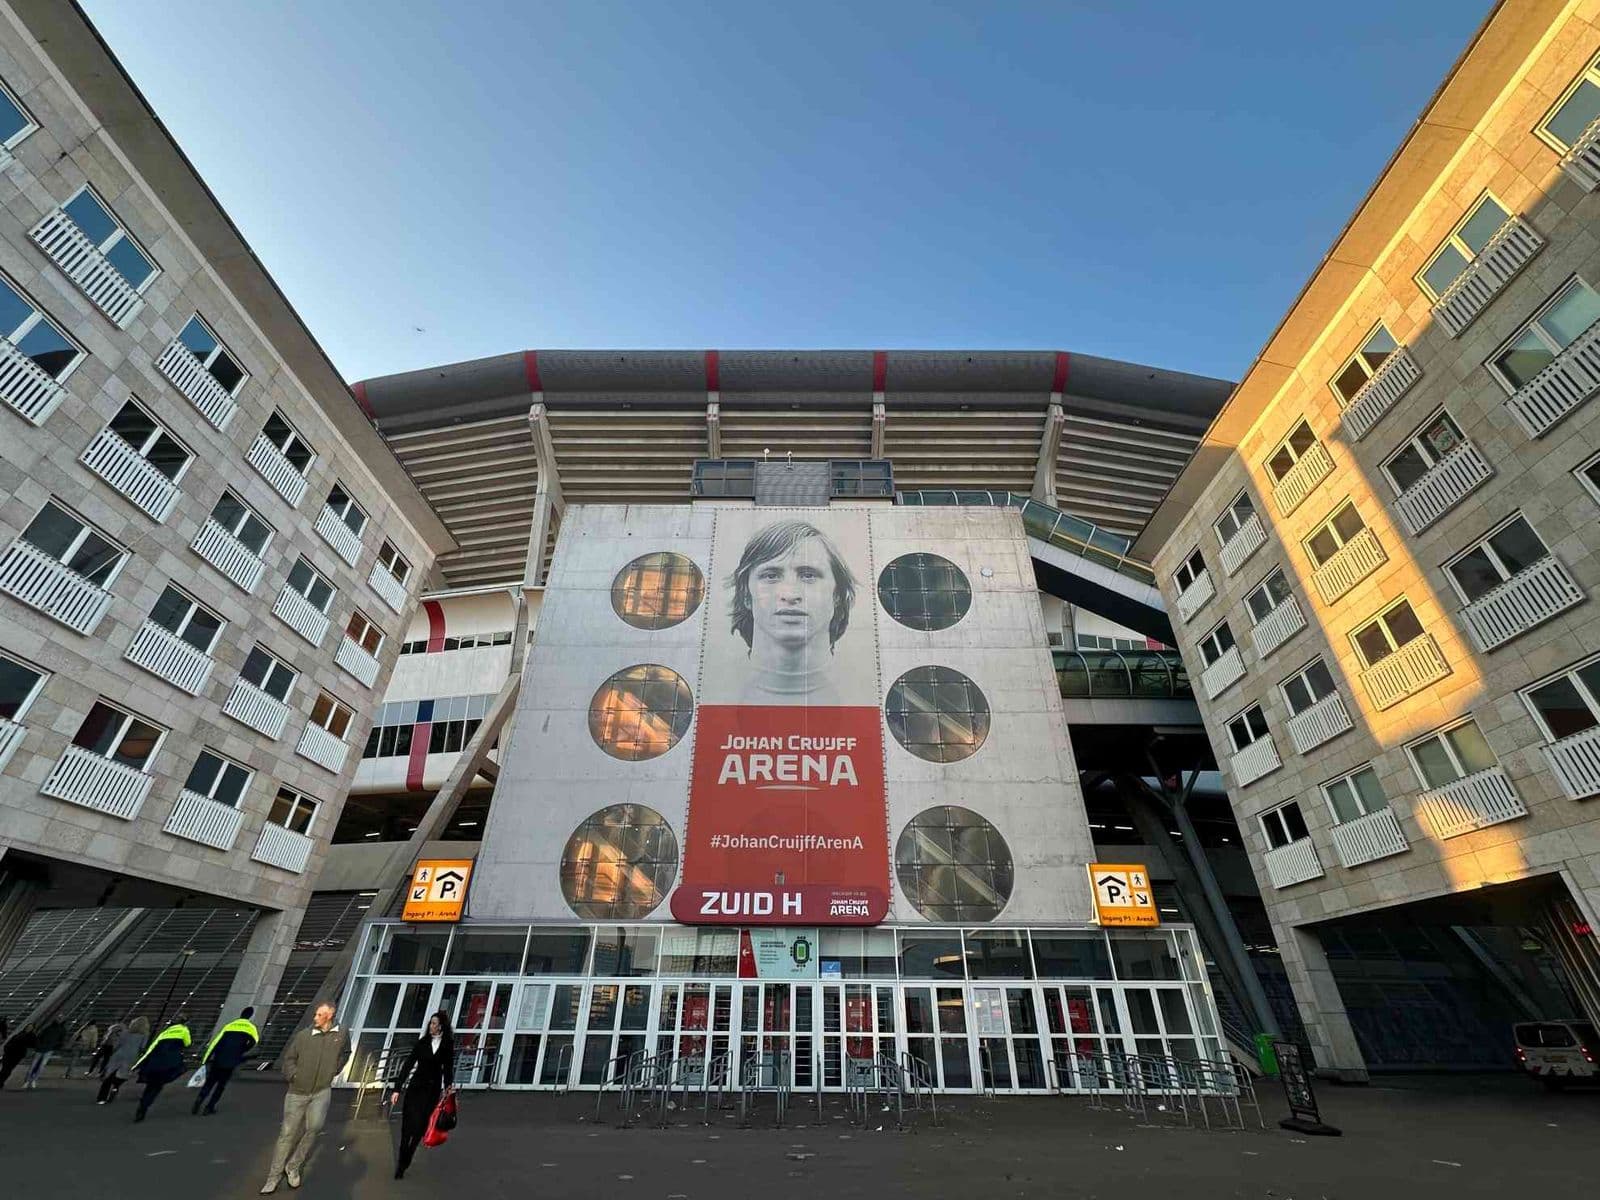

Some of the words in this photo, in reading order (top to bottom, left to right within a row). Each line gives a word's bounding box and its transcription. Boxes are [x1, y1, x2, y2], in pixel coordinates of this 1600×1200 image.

[718, 754, 859, 786] ARENA
[710, 835, 864, 853] #JohanCruijffArenA
[700, 892, 774, 915] ZUID
[783, 893, 802, 915] H
[830, 905, 869, 916] ARENA
